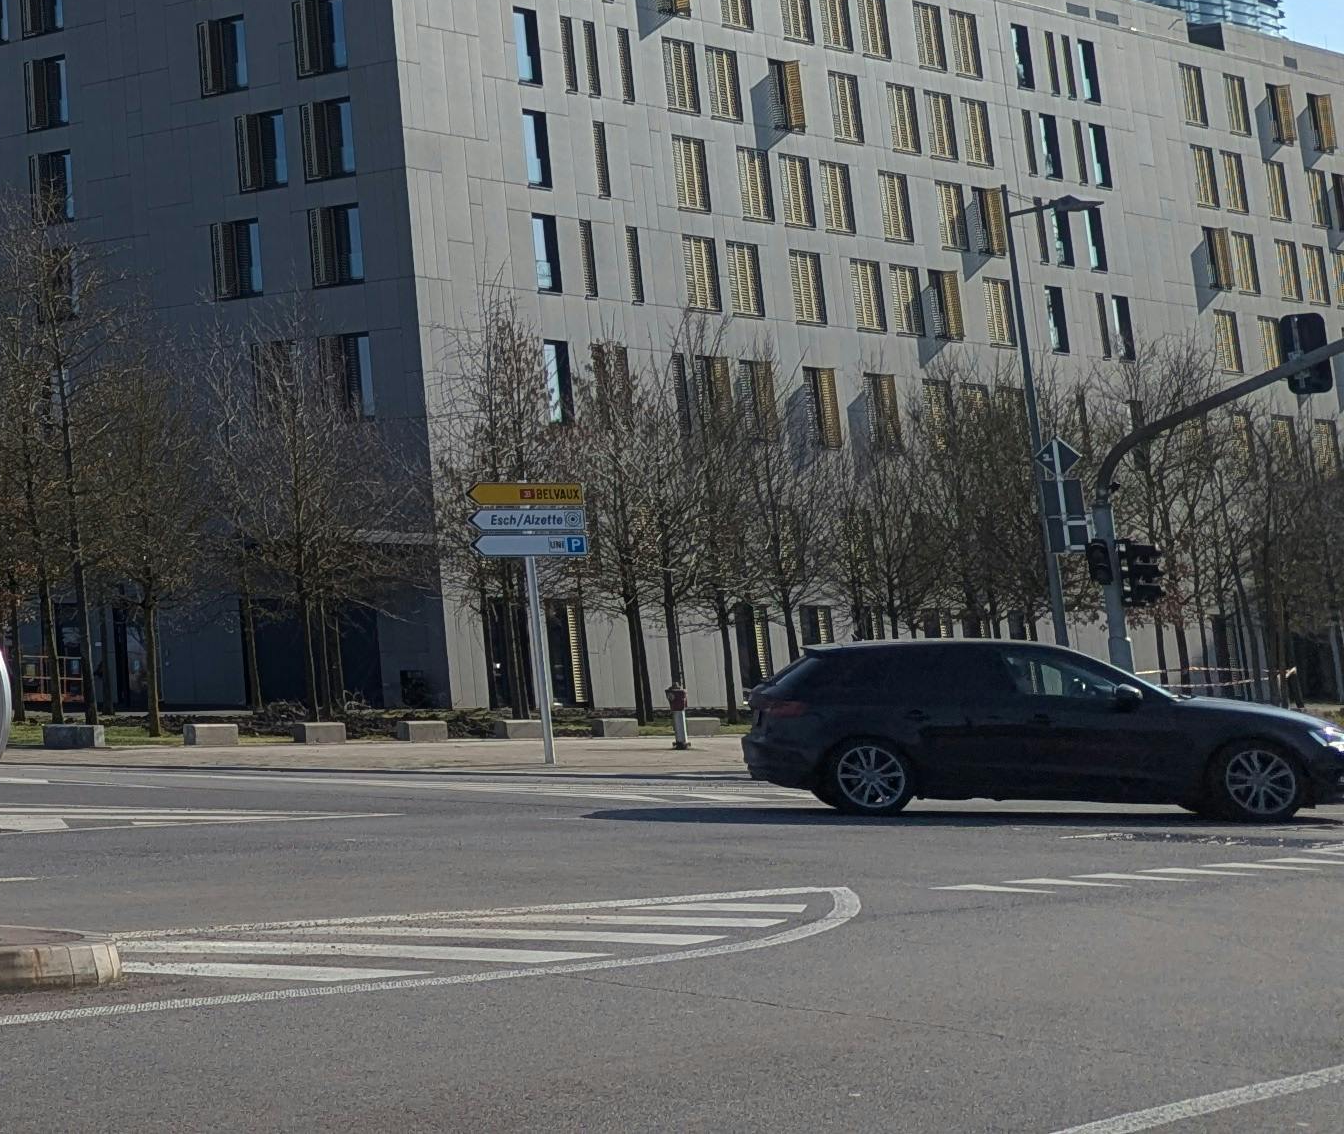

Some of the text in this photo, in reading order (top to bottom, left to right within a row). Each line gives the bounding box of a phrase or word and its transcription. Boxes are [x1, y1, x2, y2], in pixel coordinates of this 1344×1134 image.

[536, 488, 580, 500] BELVAUX
[490, 513, 563, 527] Esch/Alzette
[549, 538, 581, 552] UNI P
